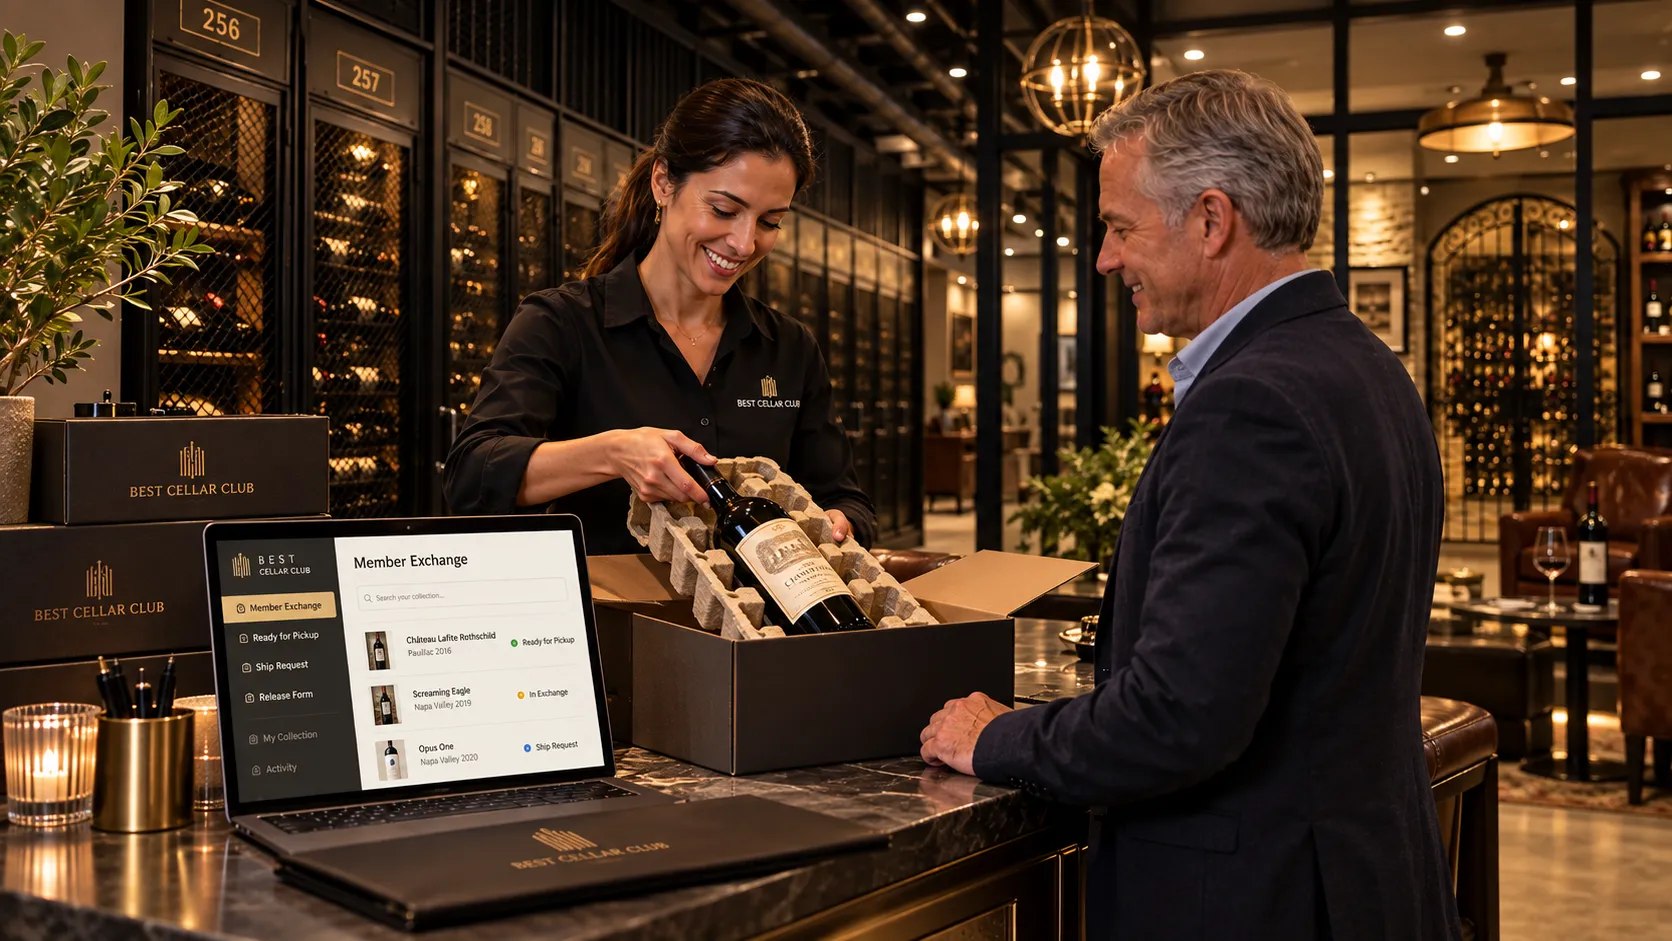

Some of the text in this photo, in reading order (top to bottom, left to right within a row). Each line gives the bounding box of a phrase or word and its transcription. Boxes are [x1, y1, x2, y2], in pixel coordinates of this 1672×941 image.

[203, 8, 240, 40] 256
[352, 65, 380, 93] 257
[737, 399, 800, 408] BEST CELLAR CLUB
[129, 482, 255, 498] BEST CELLAR CLUB
[258, 555, 295, 564] BEST
[353, 554, 468, 569] Member Exchange
[259, 566, 311, 576] CELLAR CLUB
[376, 593, 396, 602] Search
[398, 594, 411, 602] your
[34, 601, 165, 622] BEST CELLAR CLUB
[250, 602, 322, 611] Member Exchange
[253, 631, 319, 643] Ready for Pickup
[437, 633, 458, 643] Lafite
[459, 631, 496, 641] Rothschild
[522, 635, 575, 648] Ready for Pickup
[407, 647, 452, 656] Pauillac 2016
[256, 661, 308, 672] Ship Request
[259, 691, 313, 701] Release Form
[413, 686, 471, 699] Screaming Eagle
[529, 688, 569, 699] In Exchange
[414, 699, 472, 712] Napa Valley 2019
[263, 731, 317, 744] My Collection
[419, 743, 454, 754] Opus One
[536, 741, 578, 751] Ship Request
[421, 754, 478, 766] Napa Valley 2020
[266, 763, 298, 774] Activity
[511, 858, 555, 869] BEST
[558, 849, 625, 862] CELLAR
[626, 843, 670, 853] CLUB
